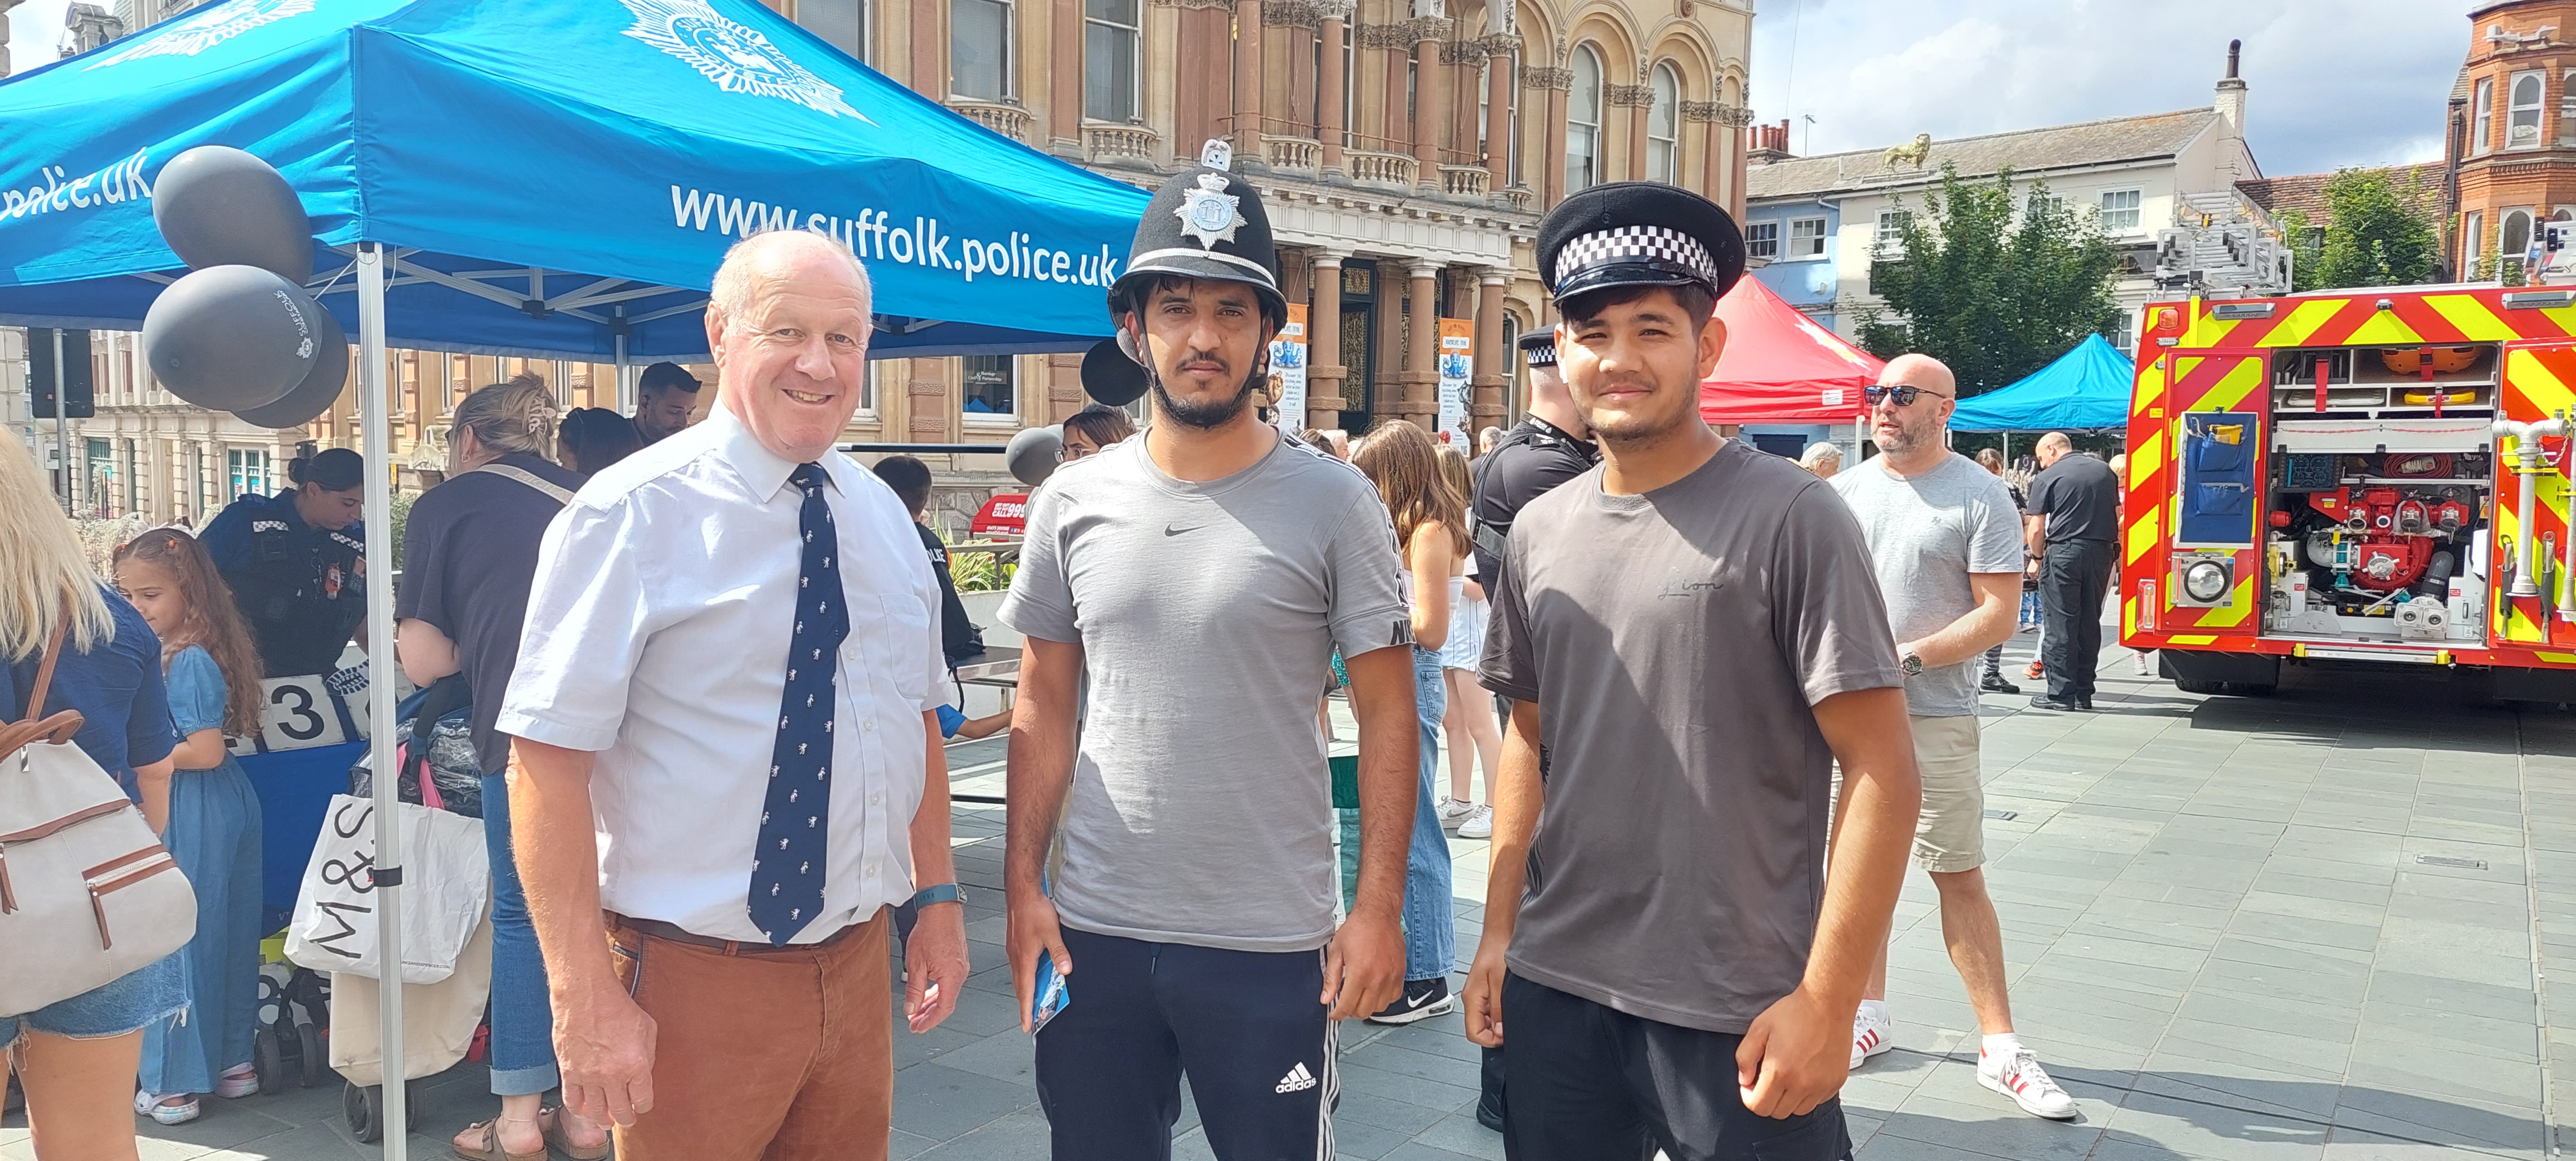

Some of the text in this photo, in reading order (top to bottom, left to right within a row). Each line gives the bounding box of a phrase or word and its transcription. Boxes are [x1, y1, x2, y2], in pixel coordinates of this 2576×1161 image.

[671, 184, 1119, 287] wwwsuffolk.police.uk
[273, 290, 304, 336] SUFFOLK
[514, 471, 574, 501] MICHA
[926, 548, 946, 563] OLICE
[1390, 619, 1416, 646] NIK
[271, 685, 325, 740] 3
[309, 802, 377, 959] M&S
[401, 960, 450, 969] RKSANDSPENCER.COM
[1276, 1077, 1316, 1094] adidas
